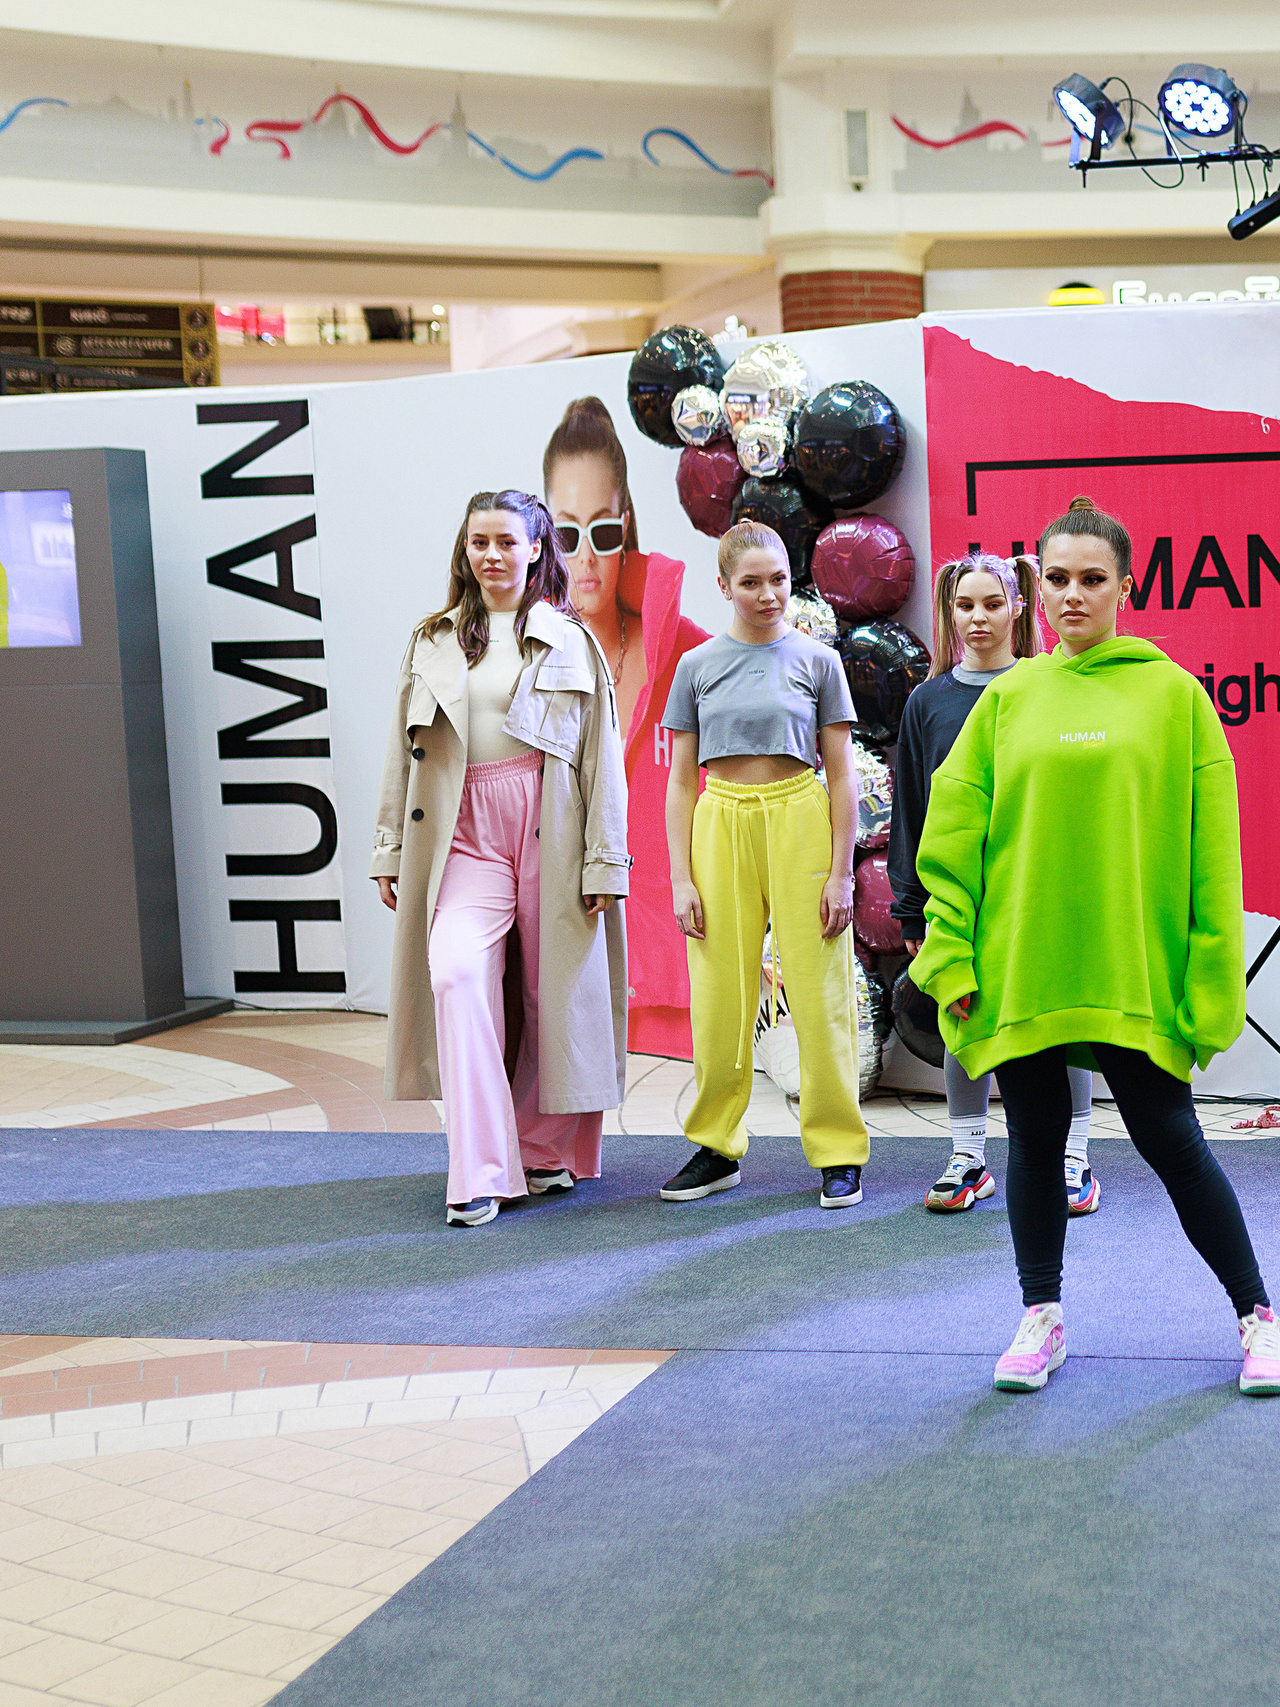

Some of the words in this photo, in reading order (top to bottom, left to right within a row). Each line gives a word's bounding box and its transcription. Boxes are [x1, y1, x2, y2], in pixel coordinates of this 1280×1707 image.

[196, 399, 347, 994] HUMAN
[654, 722, 670, 768] H
[1060, 731, 1105, 742] HUMAN
